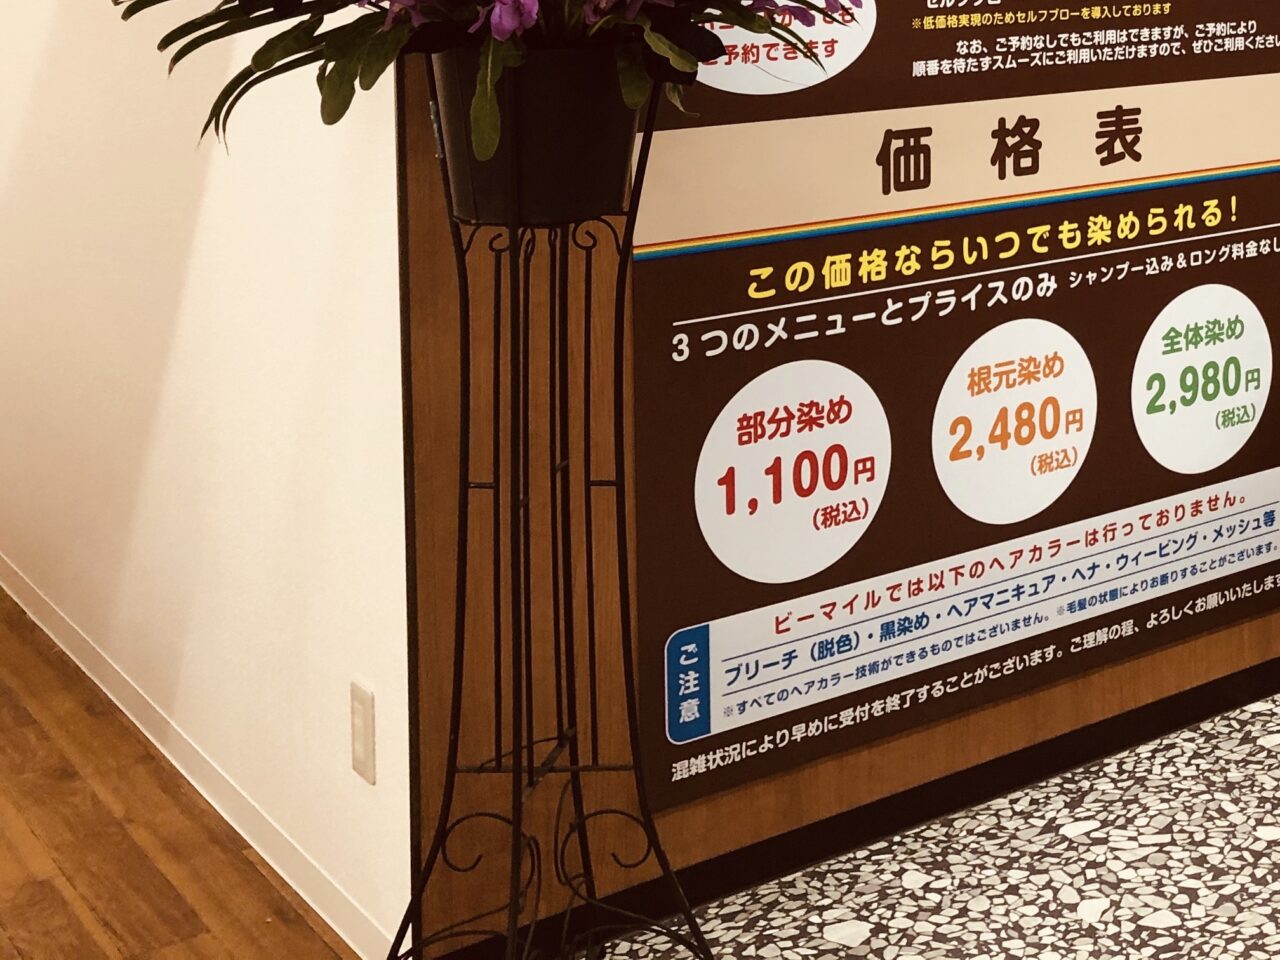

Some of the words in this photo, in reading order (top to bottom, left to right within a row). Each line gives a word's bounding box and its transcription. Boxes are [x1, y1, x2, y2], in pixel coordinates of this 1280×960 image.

[702, 38, 839, 66] 予約できます
[875, 104, 1143, 196] 価格表
[747, 195, 1238, 299] この価格ならいつでも染められる!
[1161, 315, 1246, 356] 全体染め
[966, 350, 1065, 398] 根元染め
[1145, 356, 1261, 417] 2,980円
[736, 393, 854, 446] 部分染め
[948, 395, 1084, 462] 2,480円
[1214, 403, 1257, 432] (税込)
[716, 443, 876, 518] 1,100円
[1030, 446, 1078, 478] (税込)
[812, 498, 869, 532] (税込)
[774, 491, 1246, 635] ビーマイルでは以下のヘアカラーは行っておりません。
[678, 642, 700, 724] ご注意
